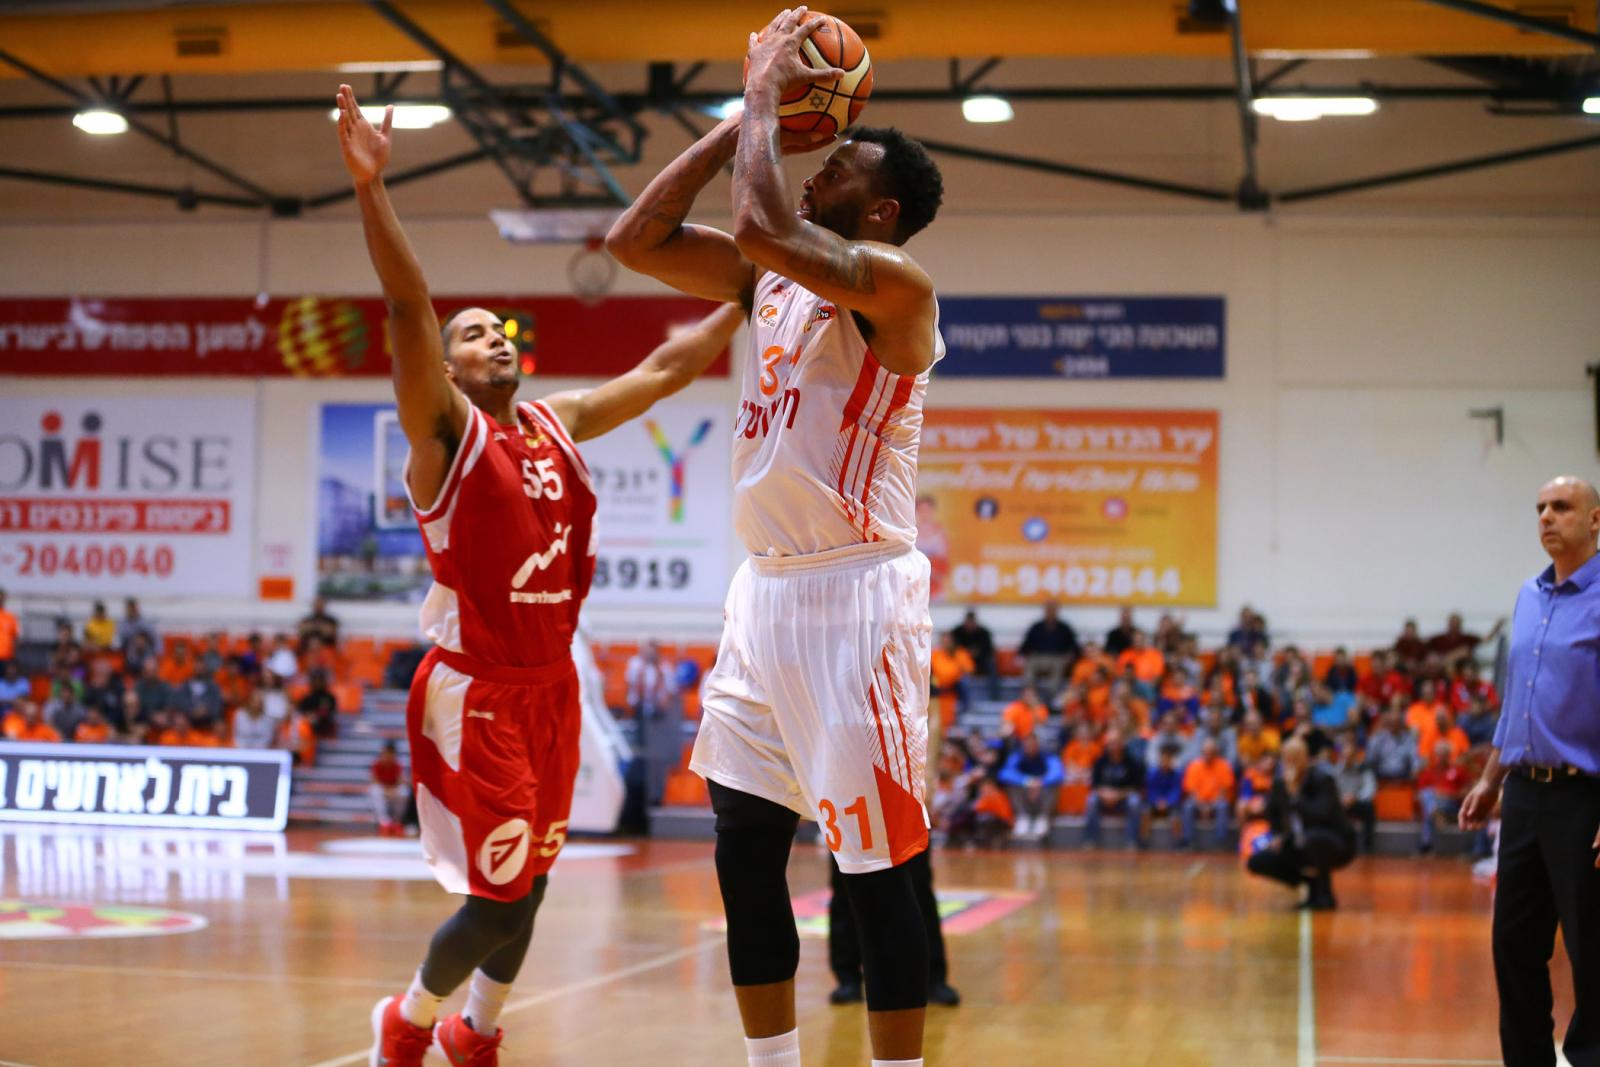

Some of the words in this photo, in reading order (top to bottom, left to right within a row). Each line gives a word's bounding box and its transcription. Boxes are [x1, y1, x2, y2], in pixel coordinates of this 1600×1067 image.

[521, 457, 563, 501] 55
[2, 544, 175, 577] -2040040
[15, 756, 173, 814] לארועים
[174, 763, 249, 817] בית
[533, 819, 569, 857] 5
[818, 795, 873, 852] 31
